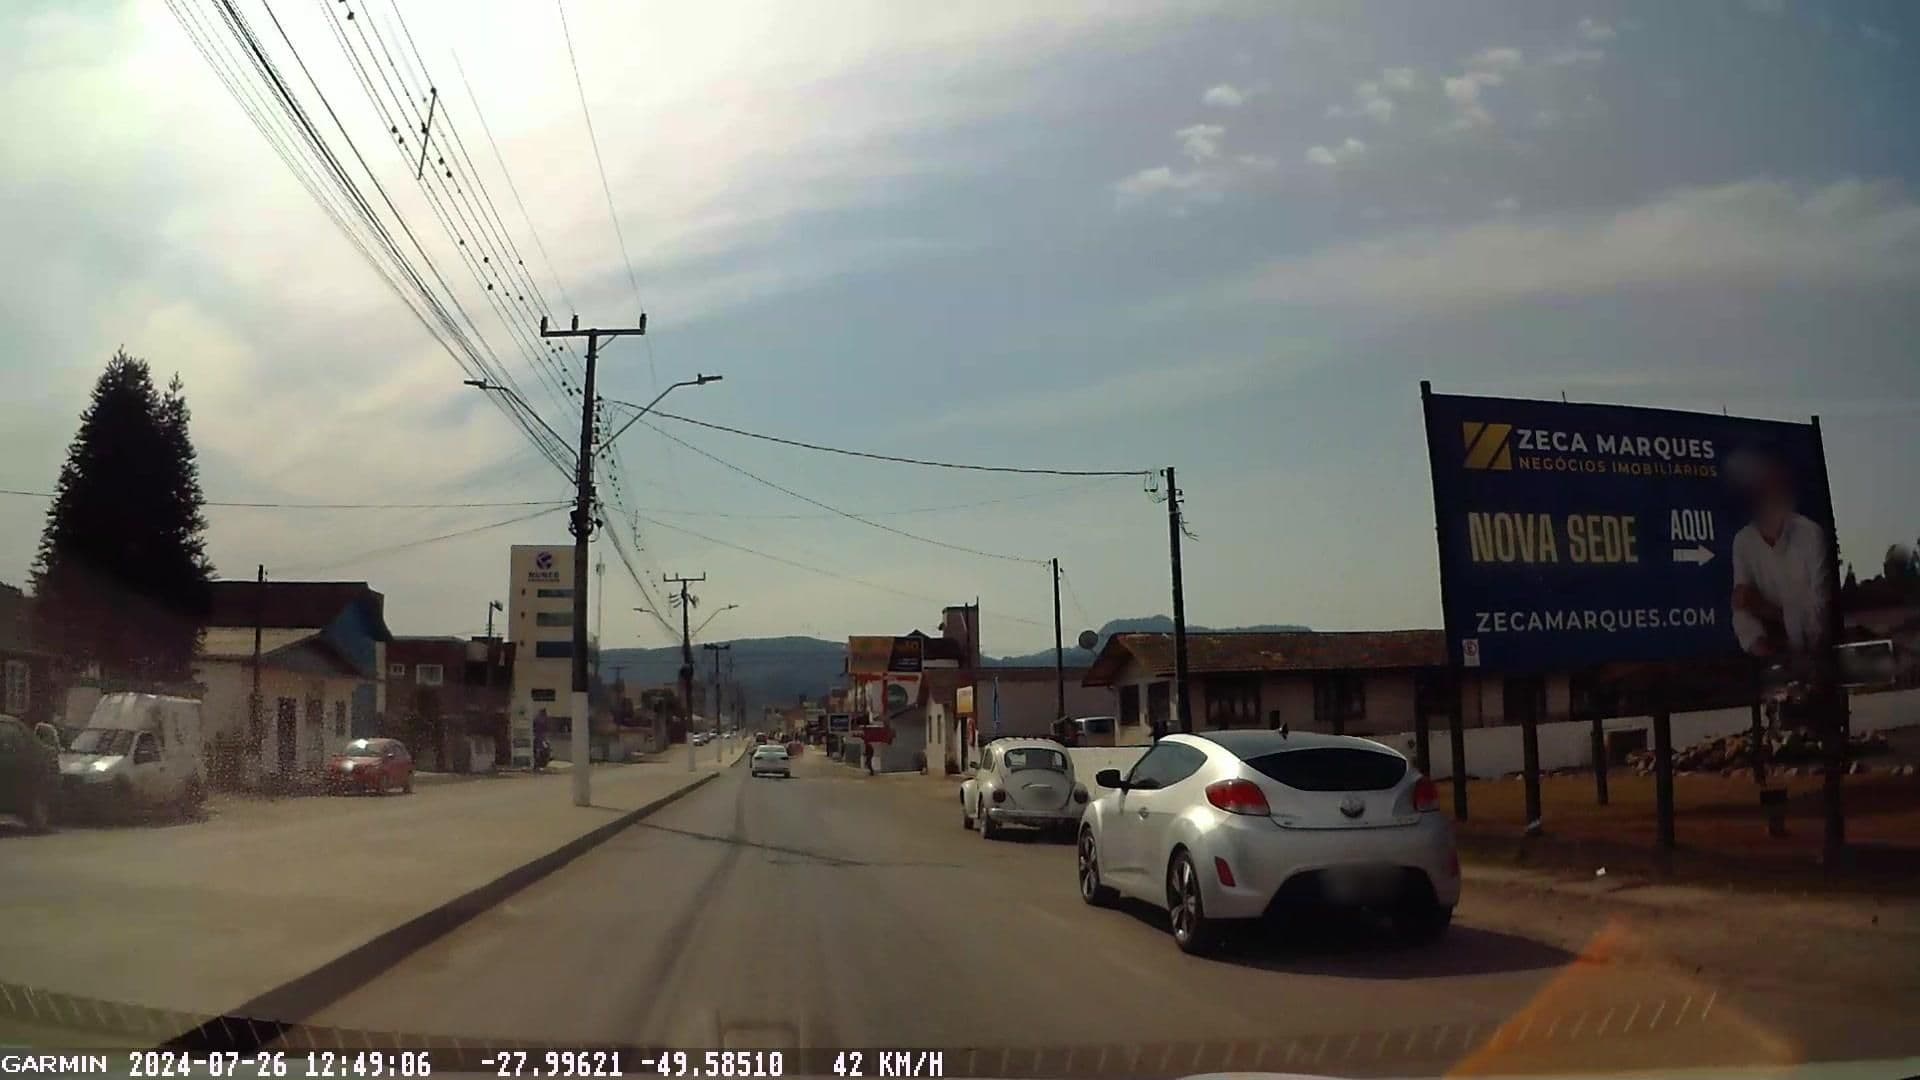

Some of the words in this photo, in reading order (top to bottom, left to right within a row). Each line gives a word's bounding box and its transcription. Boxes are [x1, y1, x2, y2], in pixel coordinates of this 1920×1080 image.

[1516, 429, 1588, 453] ZECA
[1595, 433, 1715, 460] MARQUES
[1467, 511, 1558, 563] NOVA
[1567, 514, 1639, 563] SEDE
[1670, 508, 1715, 542] AQUI
[1475, 608, 1716, 633] ZECAMARQUES.COM
